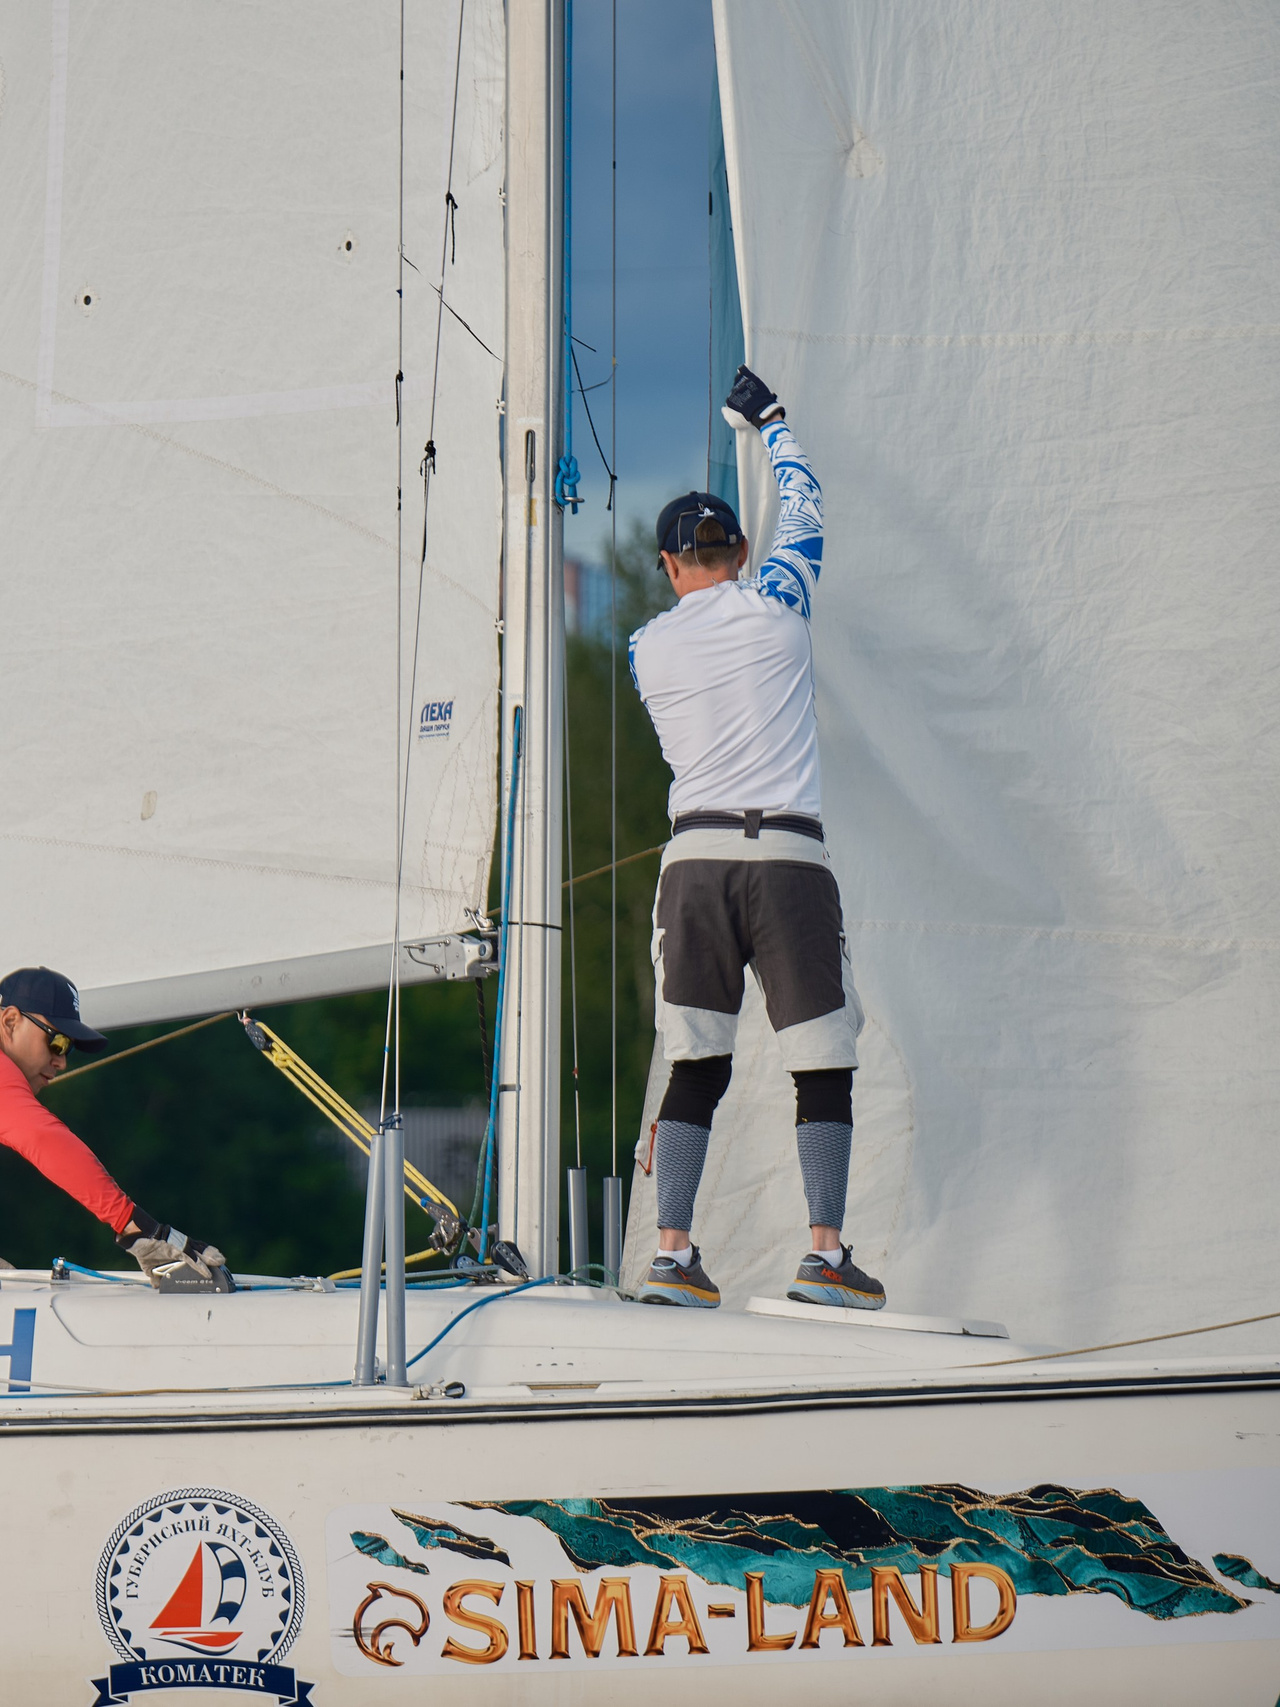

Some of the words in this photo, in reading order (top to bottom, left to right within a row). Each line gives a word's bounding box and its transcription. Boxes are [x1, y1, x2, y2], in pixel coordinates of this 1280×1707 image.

[126, 1515, 211, 1599] ГУБЕРНСКИЙ
[216, 1523, 274, 1598] ЯХТ-КЛУБ
[441, 1562, 1017, 1665] SIMA-LAND
[138, 1664, 266, 1688] КОМАТЕК
